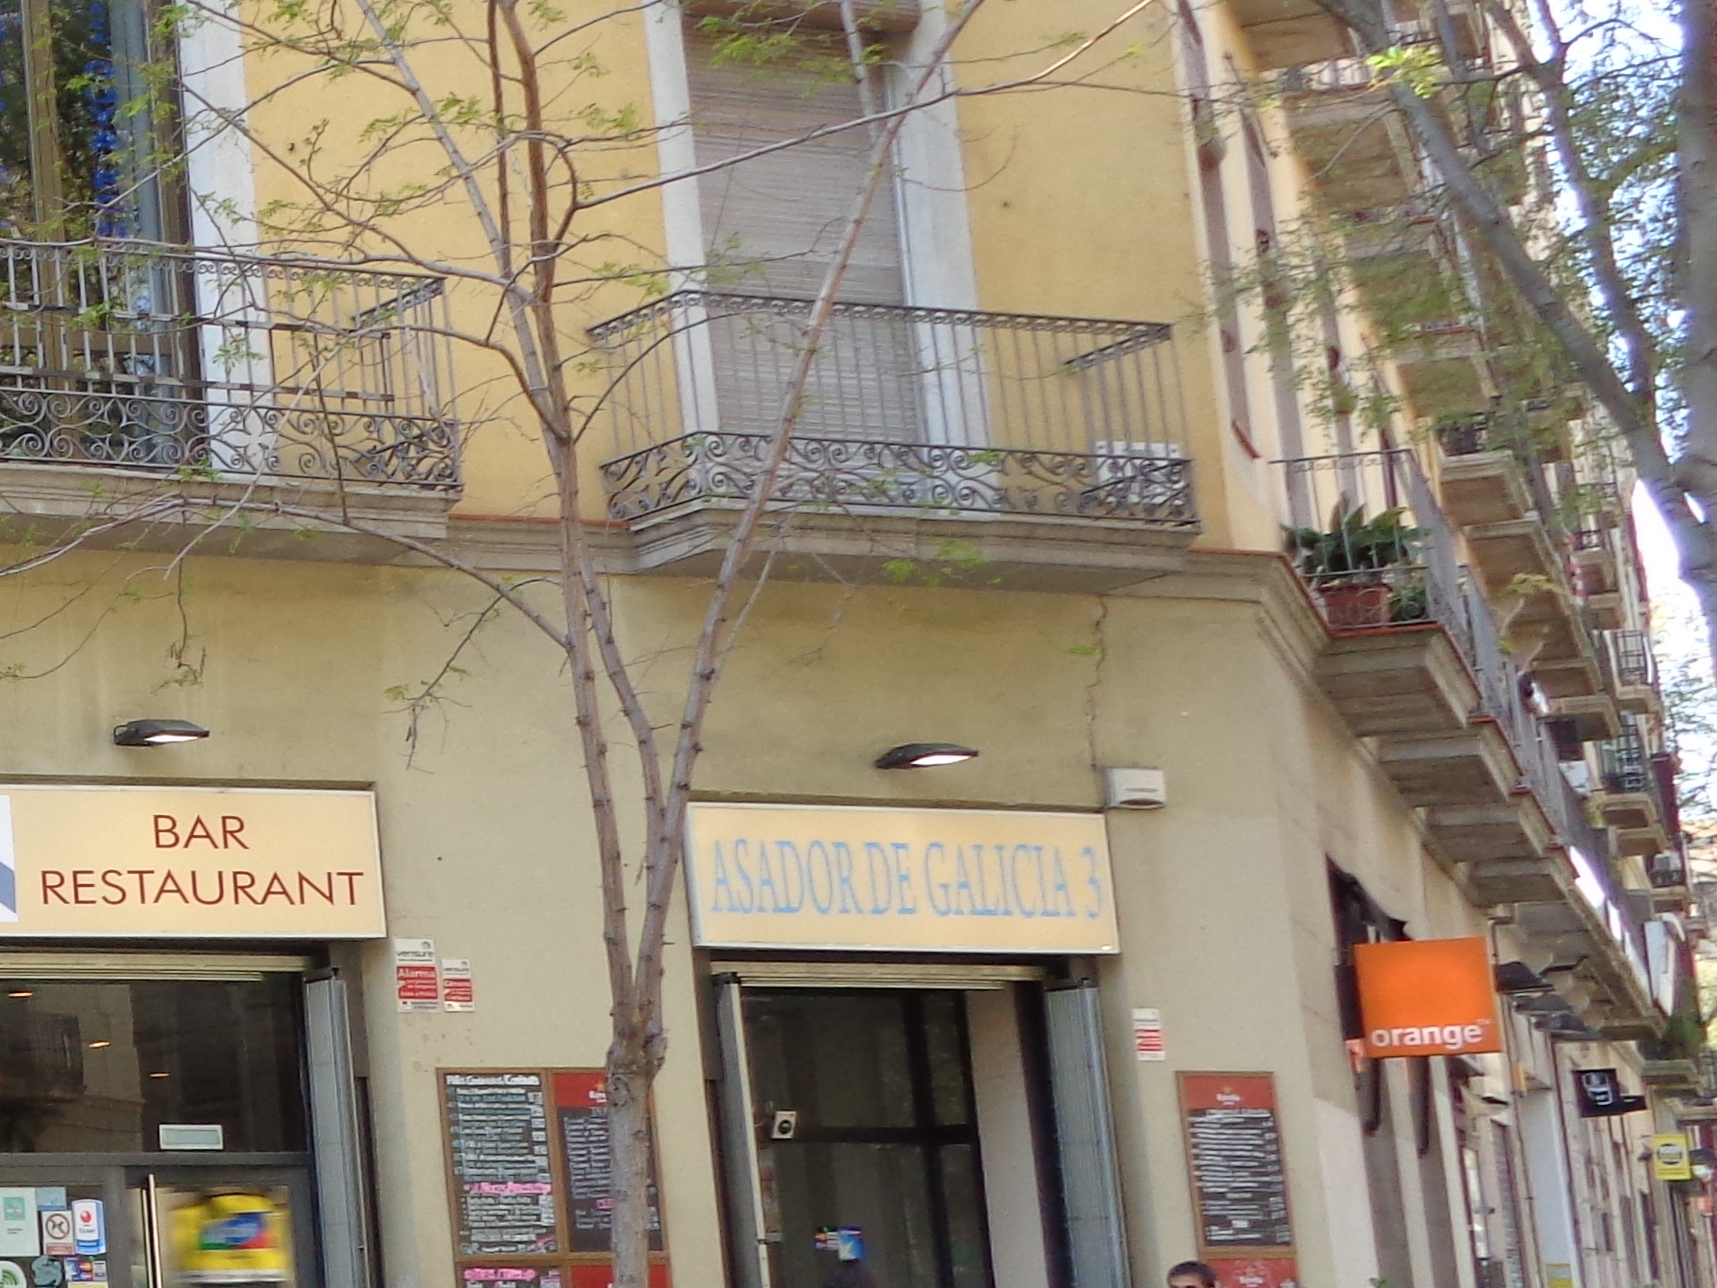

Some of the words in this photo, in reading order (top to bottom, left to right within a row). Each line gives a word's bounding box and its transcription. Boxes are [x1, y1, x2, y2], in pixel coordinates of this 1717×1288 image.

[152, 813, 251, 851] BAR
[40, 868, 365, 907] RESTAURANT
[710, 838, 867, 914] ASADOR
[865, 841, 917, 915] DE
[923, 841, 1077, 920] GALICIA
[1081, 845, 1103, 921] 3
[1369, 1023, 1484, 1052] orange
